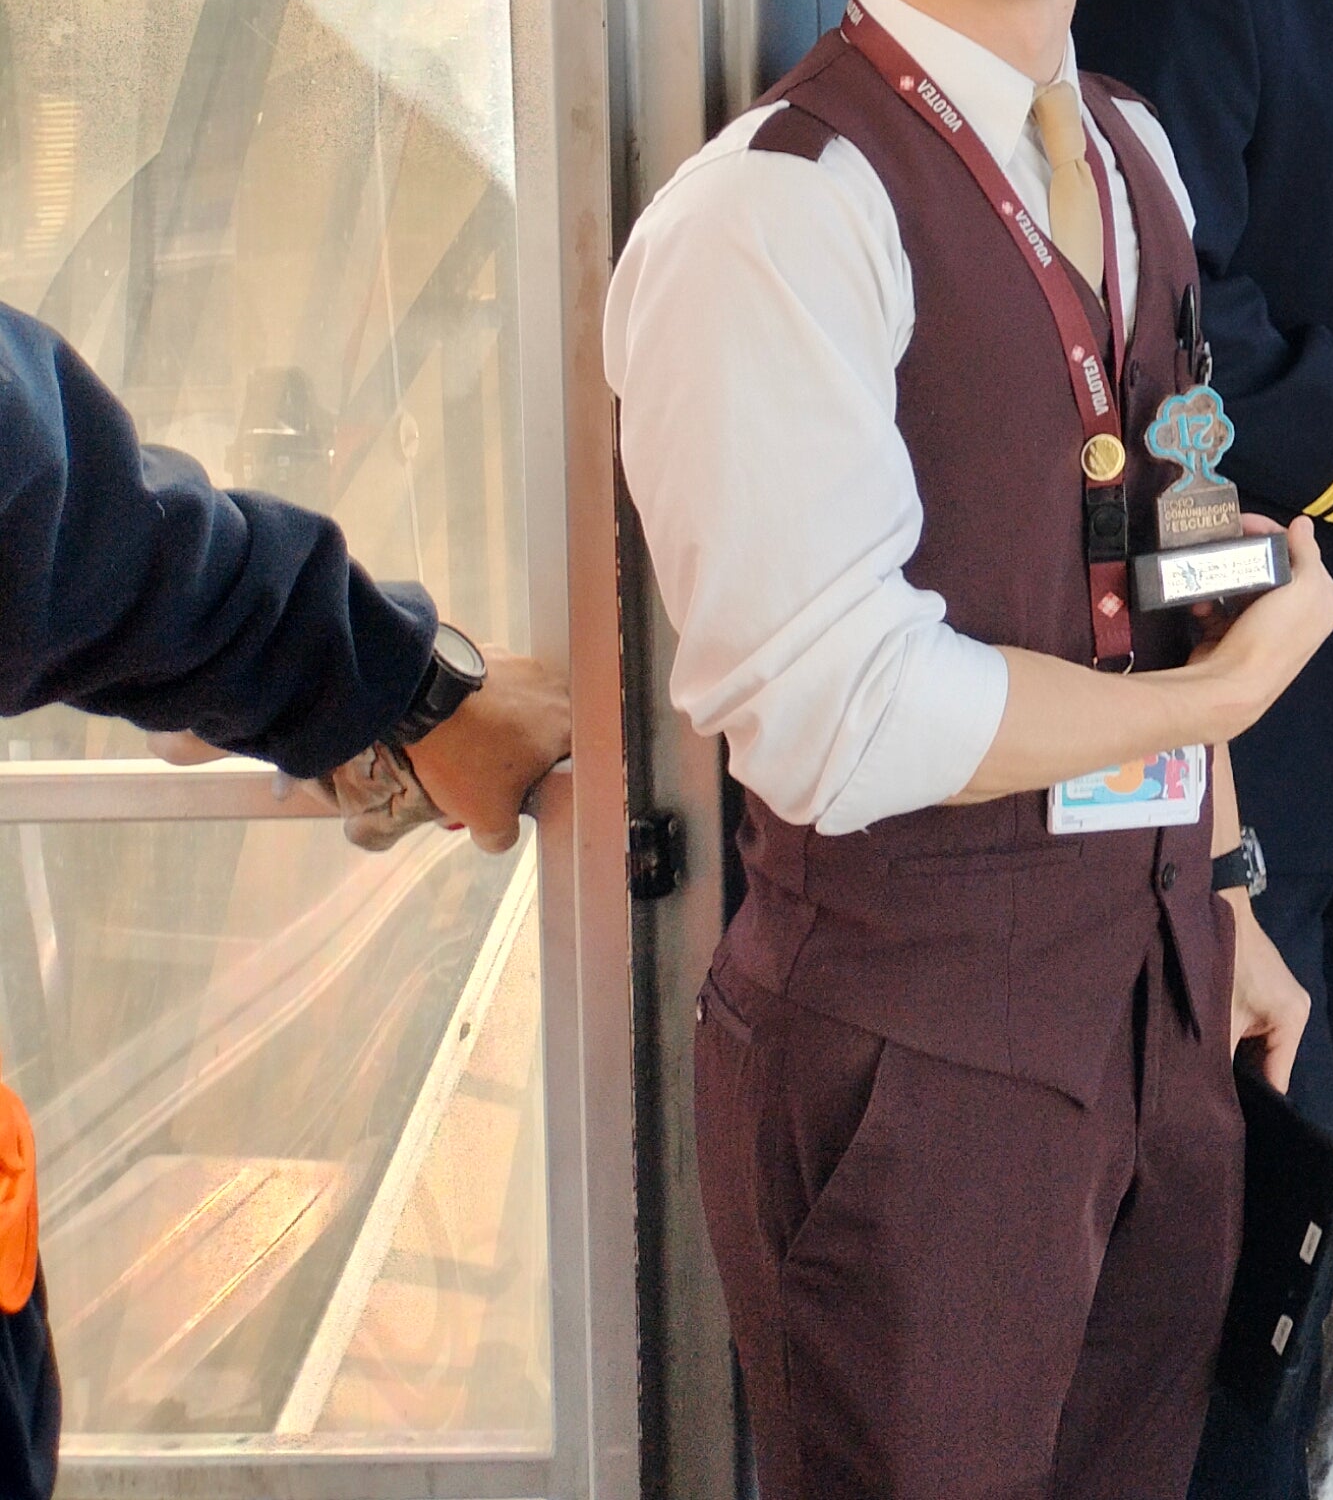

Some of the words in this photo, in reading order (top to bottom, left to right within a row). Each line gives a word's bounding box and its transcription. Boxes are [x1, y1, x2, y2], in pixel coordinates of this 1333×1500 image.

[916, 78, 963, 133] VOLOTEA
[1015, 209, 1053, 268] VOLOTEA
[1083, 355, 1109, 417] VOLOTEA
[1171, 513, 1230, 533] ESCUELA
